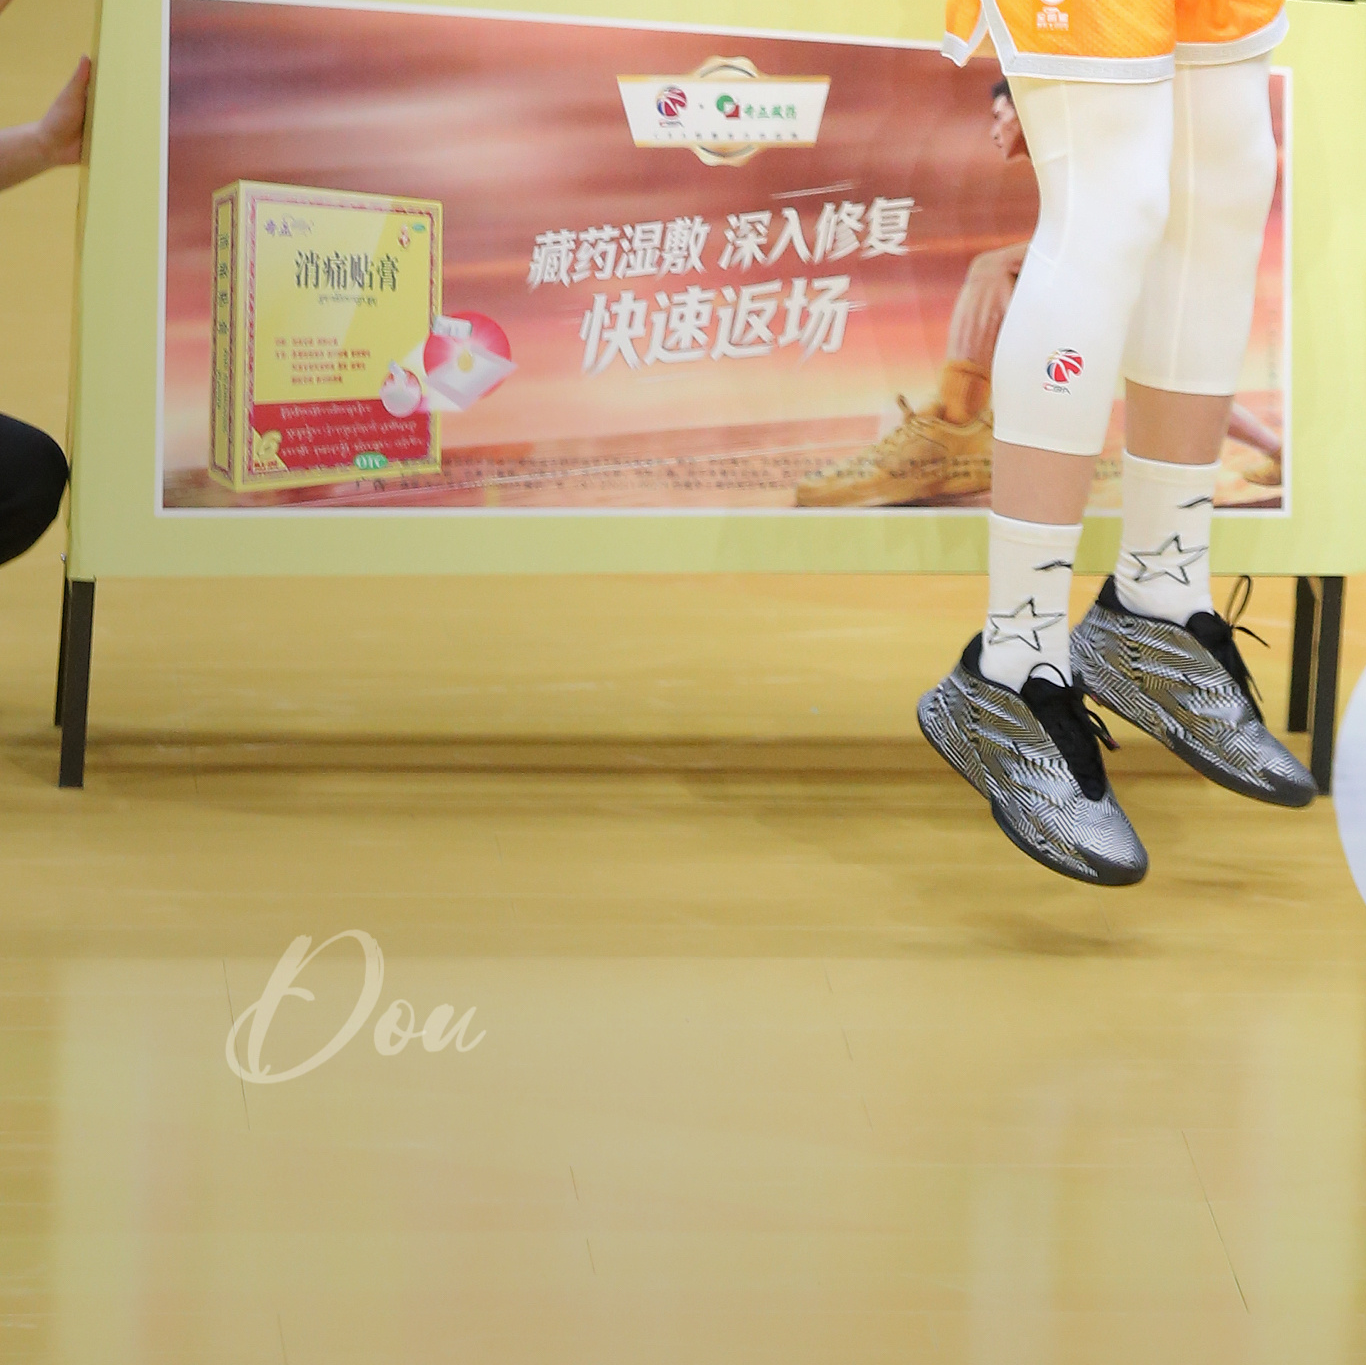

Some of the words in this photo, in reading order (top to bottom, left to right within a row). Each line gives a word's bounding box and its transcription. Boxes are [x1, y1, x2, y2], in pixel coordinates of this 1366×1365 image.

[294, 249, 400, 293] 消痛贴膏
[528, 215, 712, 292] 藏药湿敷
[716, 196, 916, 270] 深入修复
[579, 273, 852, 378] 快速返场
